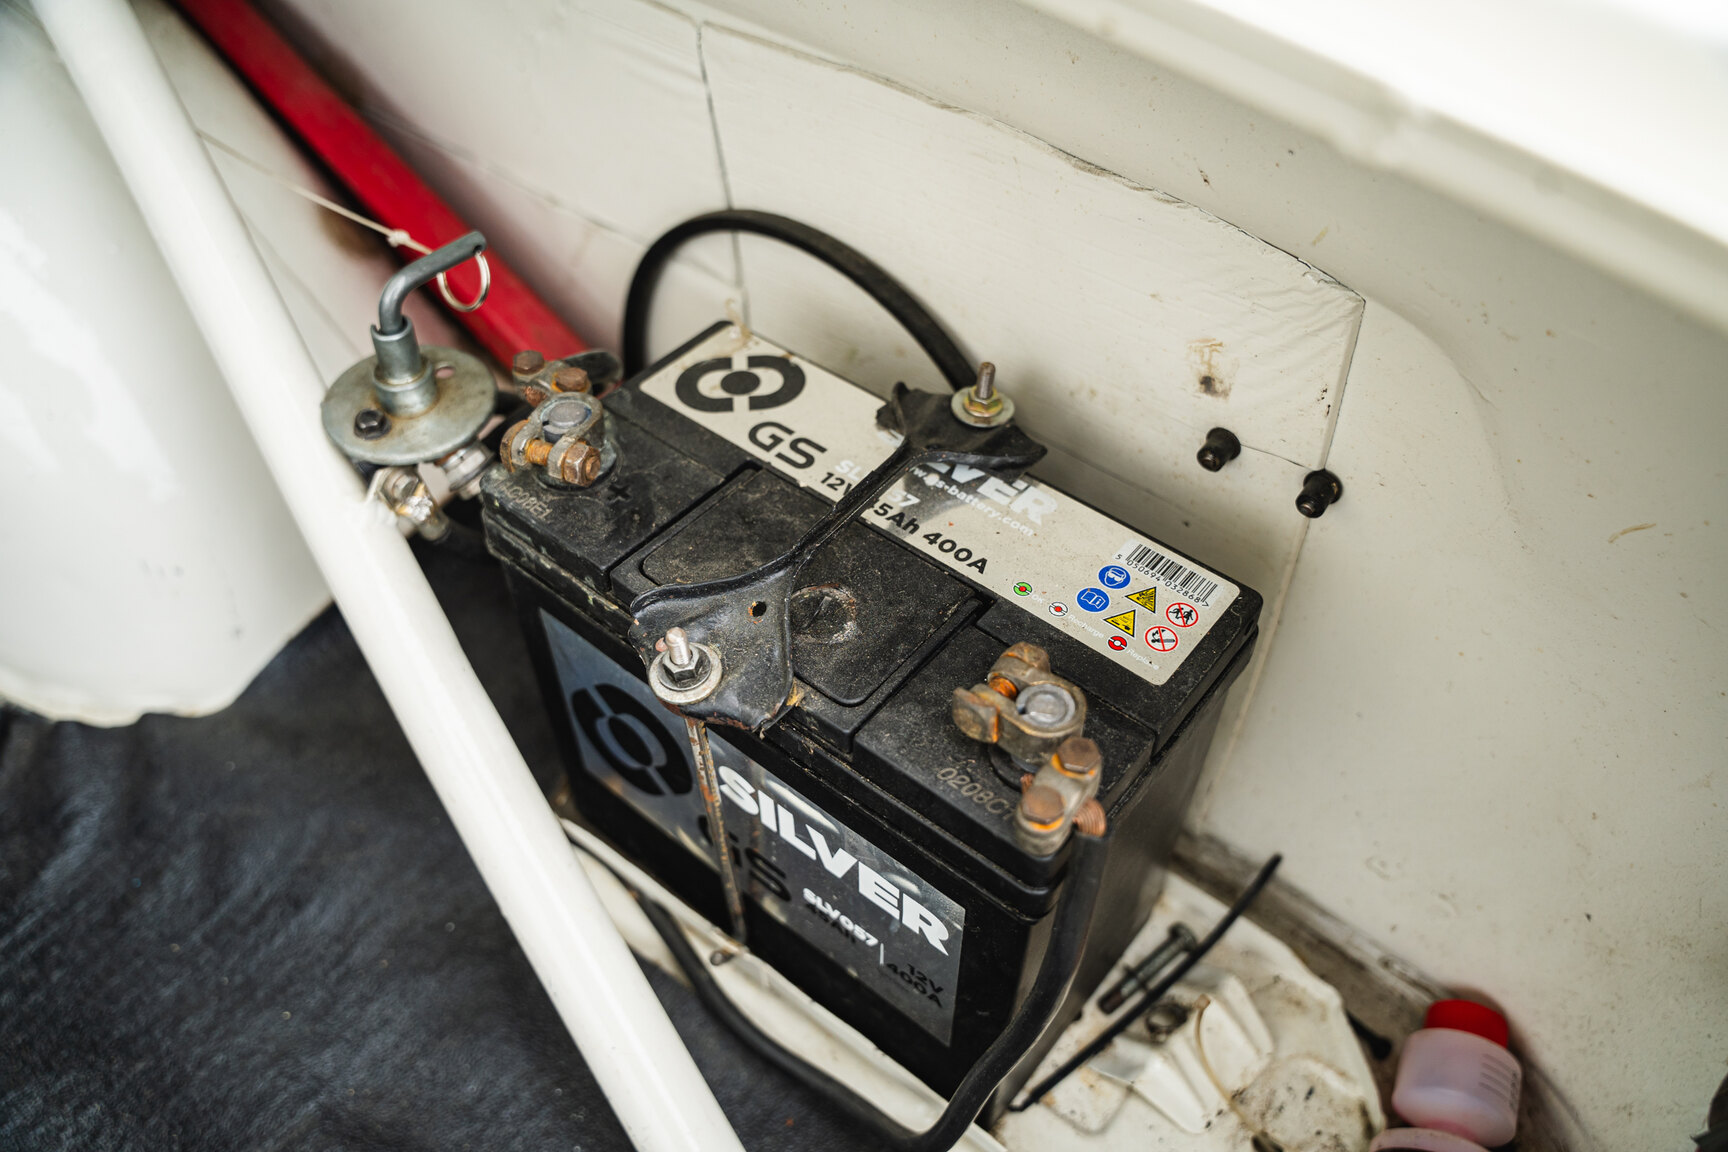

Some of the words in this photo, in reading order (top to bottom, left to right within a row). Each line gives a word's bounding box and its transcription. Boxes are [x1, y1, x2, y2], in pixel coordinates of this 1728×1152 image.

[748, 421, 828, 470] GS
[870, 502, 920, 536] 5Ah
[923, 532, 989, 575] 400A
[1115, 553, 1123, 561] 5
[1126, 560, 1161, 582] 050694
[1164, 580, 1201, 604] 032868
[718, 765, 950, 956] SILVER
[906, 963, 944, 994] 12V
